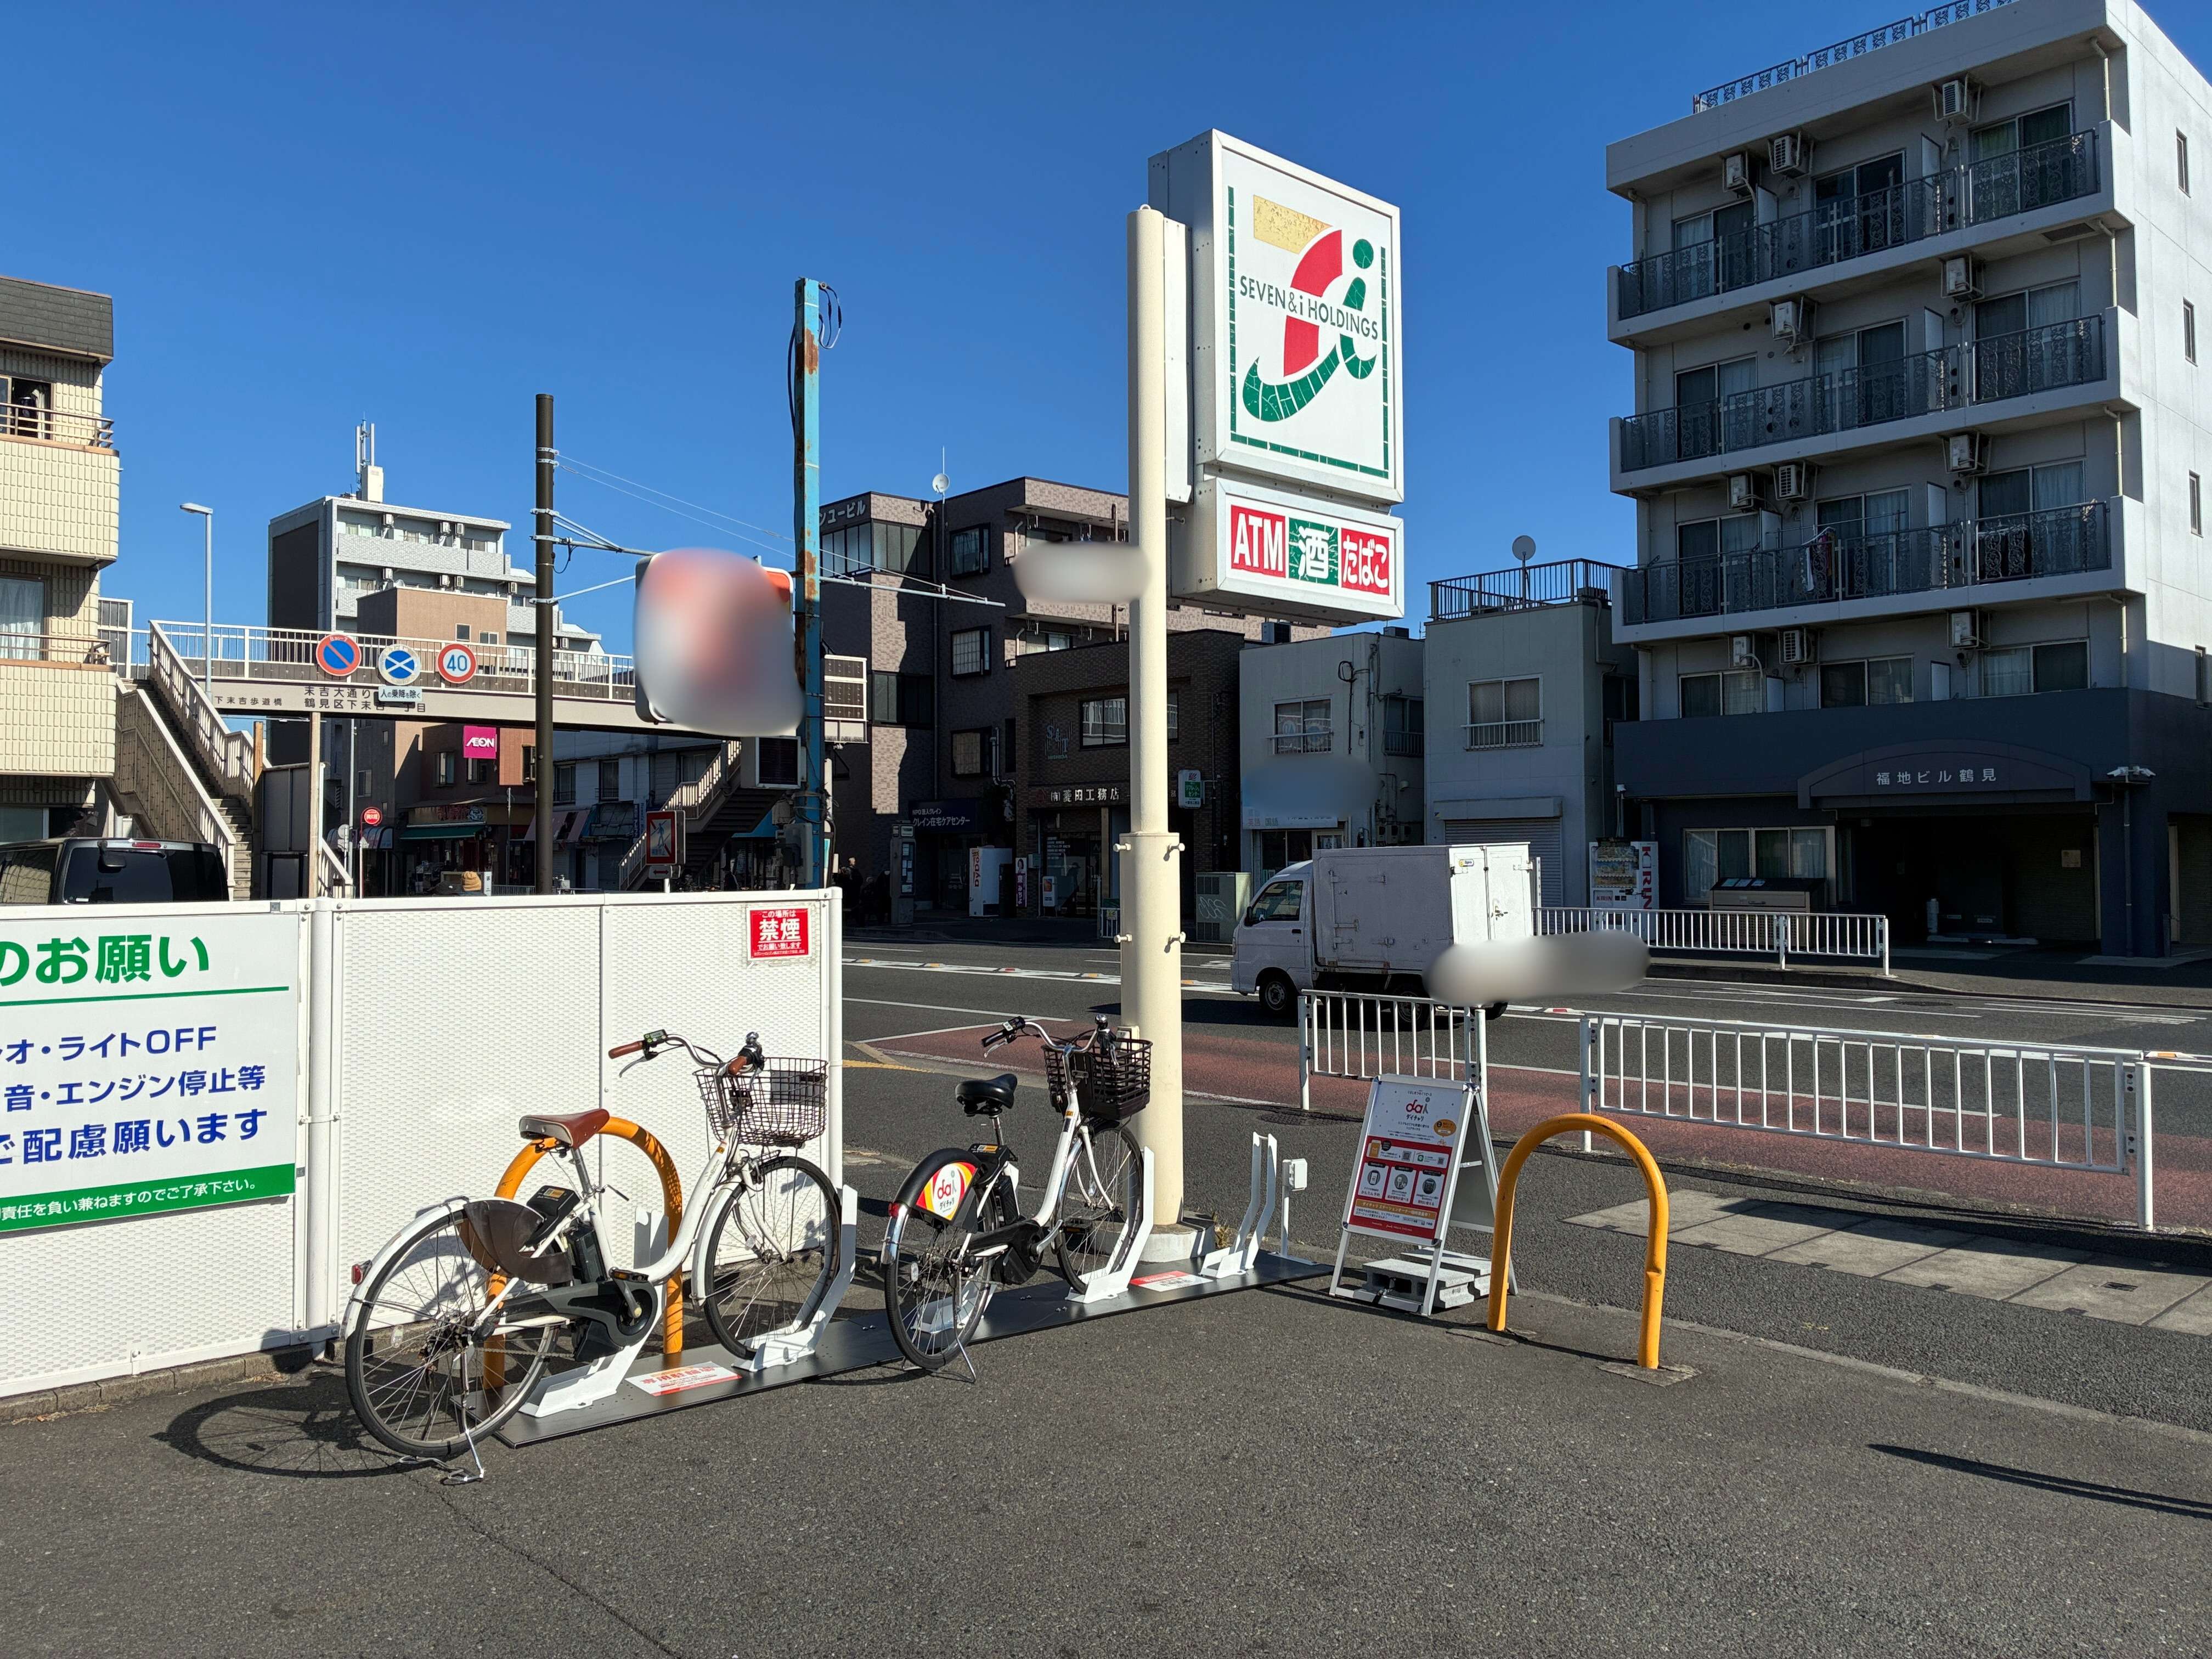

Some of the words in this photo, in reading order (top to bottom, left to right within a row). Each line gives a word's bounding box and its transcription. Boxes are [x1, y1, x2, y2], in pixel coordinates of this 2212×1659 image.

[1308, 298, 1378, 340] HOLDINGS
[1233, 512, 1284, 572] ATM
[1298, 525, 1330, 579] 酒
[1342, 534, 1389, 589] たばこ
[447, 654, 468, 672] 40
[215, 696, 282, 706] 下末吉歩道橋
[304, 686, 370, 699] 末吉大通り
[380, 689, 421, 699] 人の乗降を除く
[1876, 768, 1997, 786] 福地ビル鶴見
[913, 816, 970, 827] クレイン在宅ケアセンター
[1642, 847, 1652, 909] KRIN
[761, 910, 797, 918] この場所は
[759, 918, 801, 941] 禁煙
[0, 934, 209, 987] のお願い
[0, 1026, 217, 1064] オ・ライトOFF
[4, 1065, 266, 1113] 音・エンジン停止等
